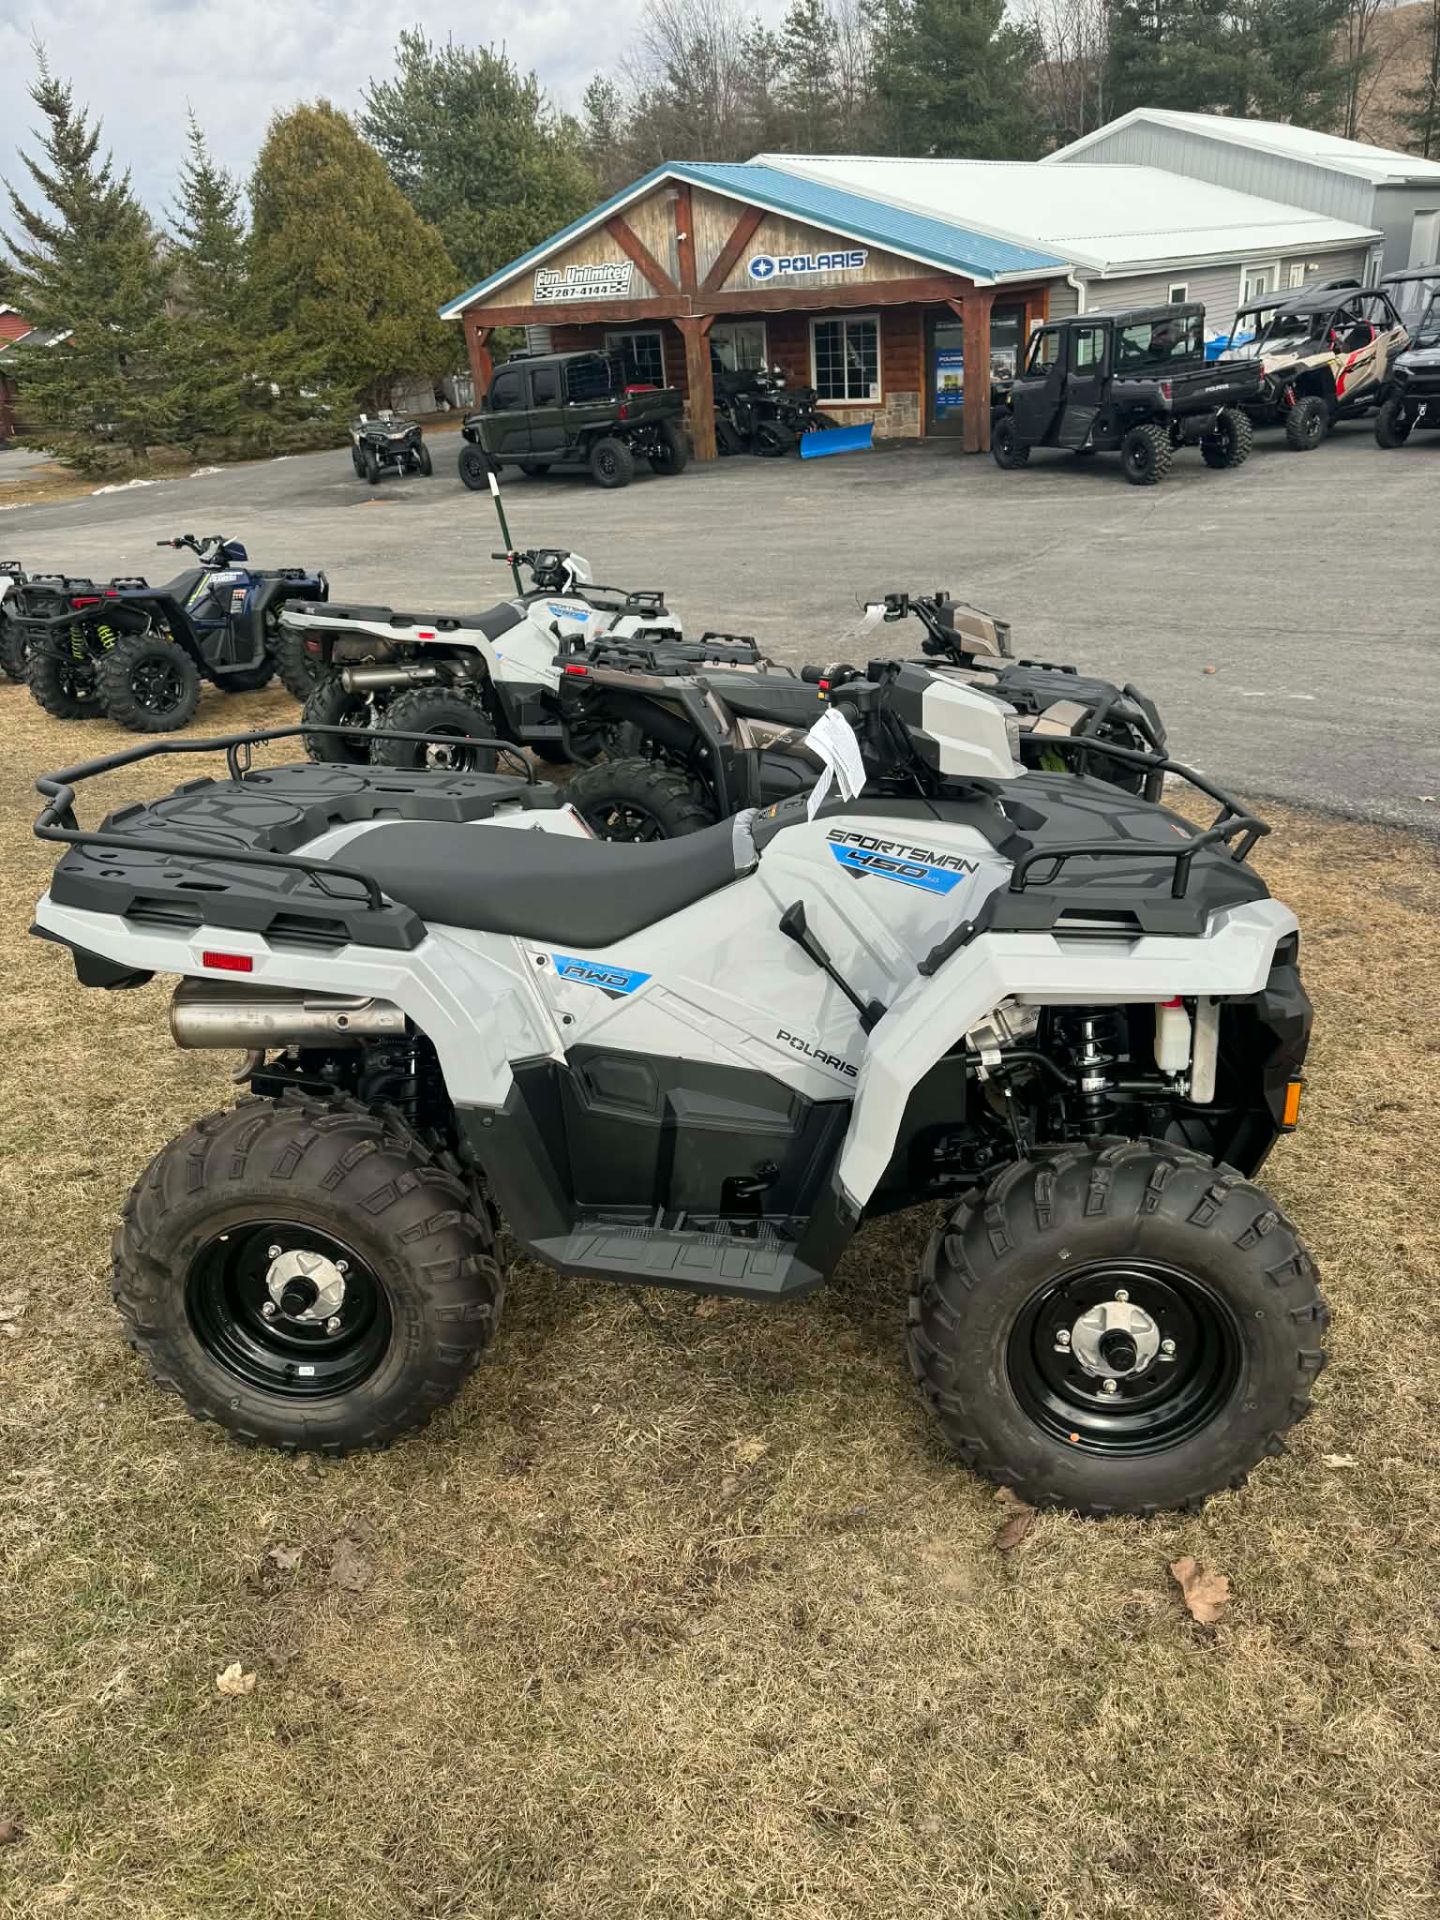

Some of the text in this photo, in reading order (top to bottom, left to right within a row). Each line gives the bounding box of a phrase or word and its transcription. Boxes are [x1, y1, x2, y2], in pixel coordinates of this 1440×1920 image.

[536, 262, 633, 287] Fun Unlimited
[778, 251, 864, 272] POLARIS
[825, 828, 980, 874] SPORTSMAN
[847, 850, 928, 879] 450
[563, 965, 629, 986] AWD
[776, 1028, 859, 1078] POLARIS
